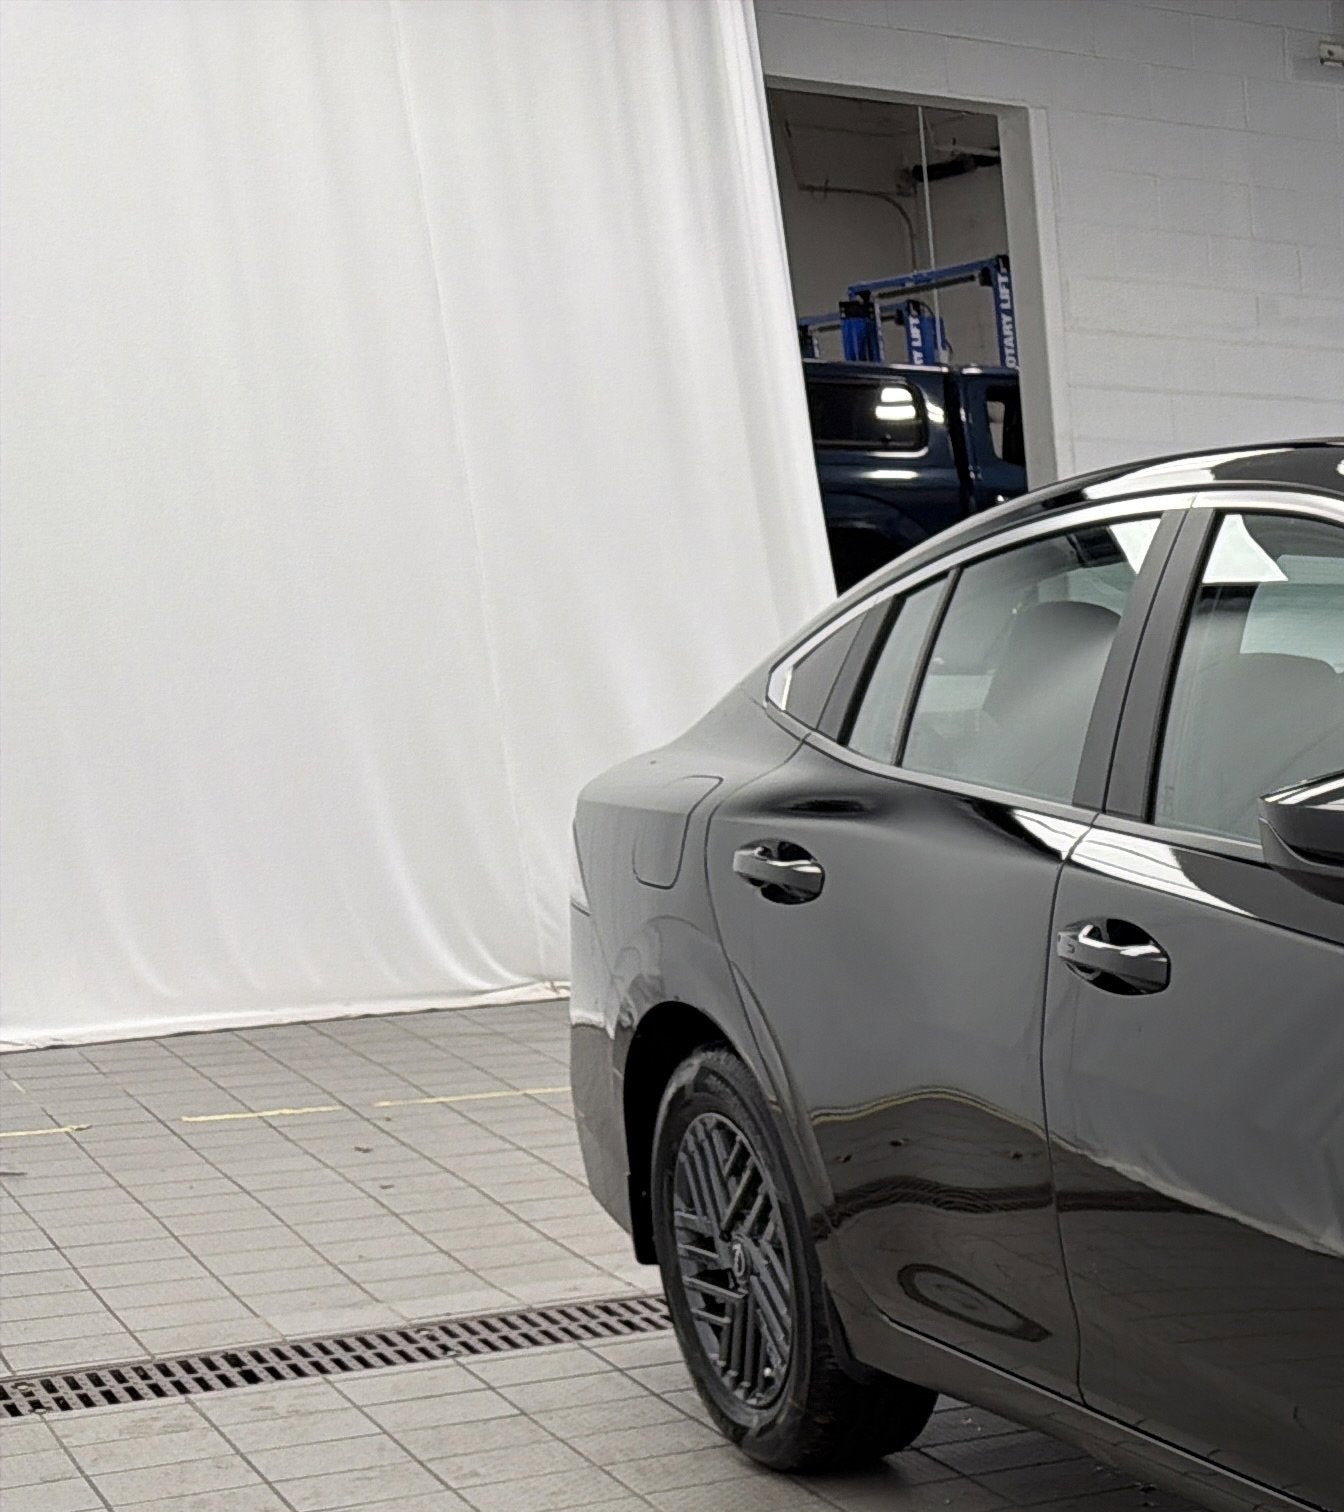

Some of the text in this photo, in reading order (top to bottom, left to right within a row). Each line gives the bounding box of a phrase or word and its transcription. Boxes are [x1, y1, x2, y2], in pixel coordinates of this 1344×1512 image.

[909, 316, 922, 347] LIFT
[998, 273, 1016, 369] OTARY LIFT
